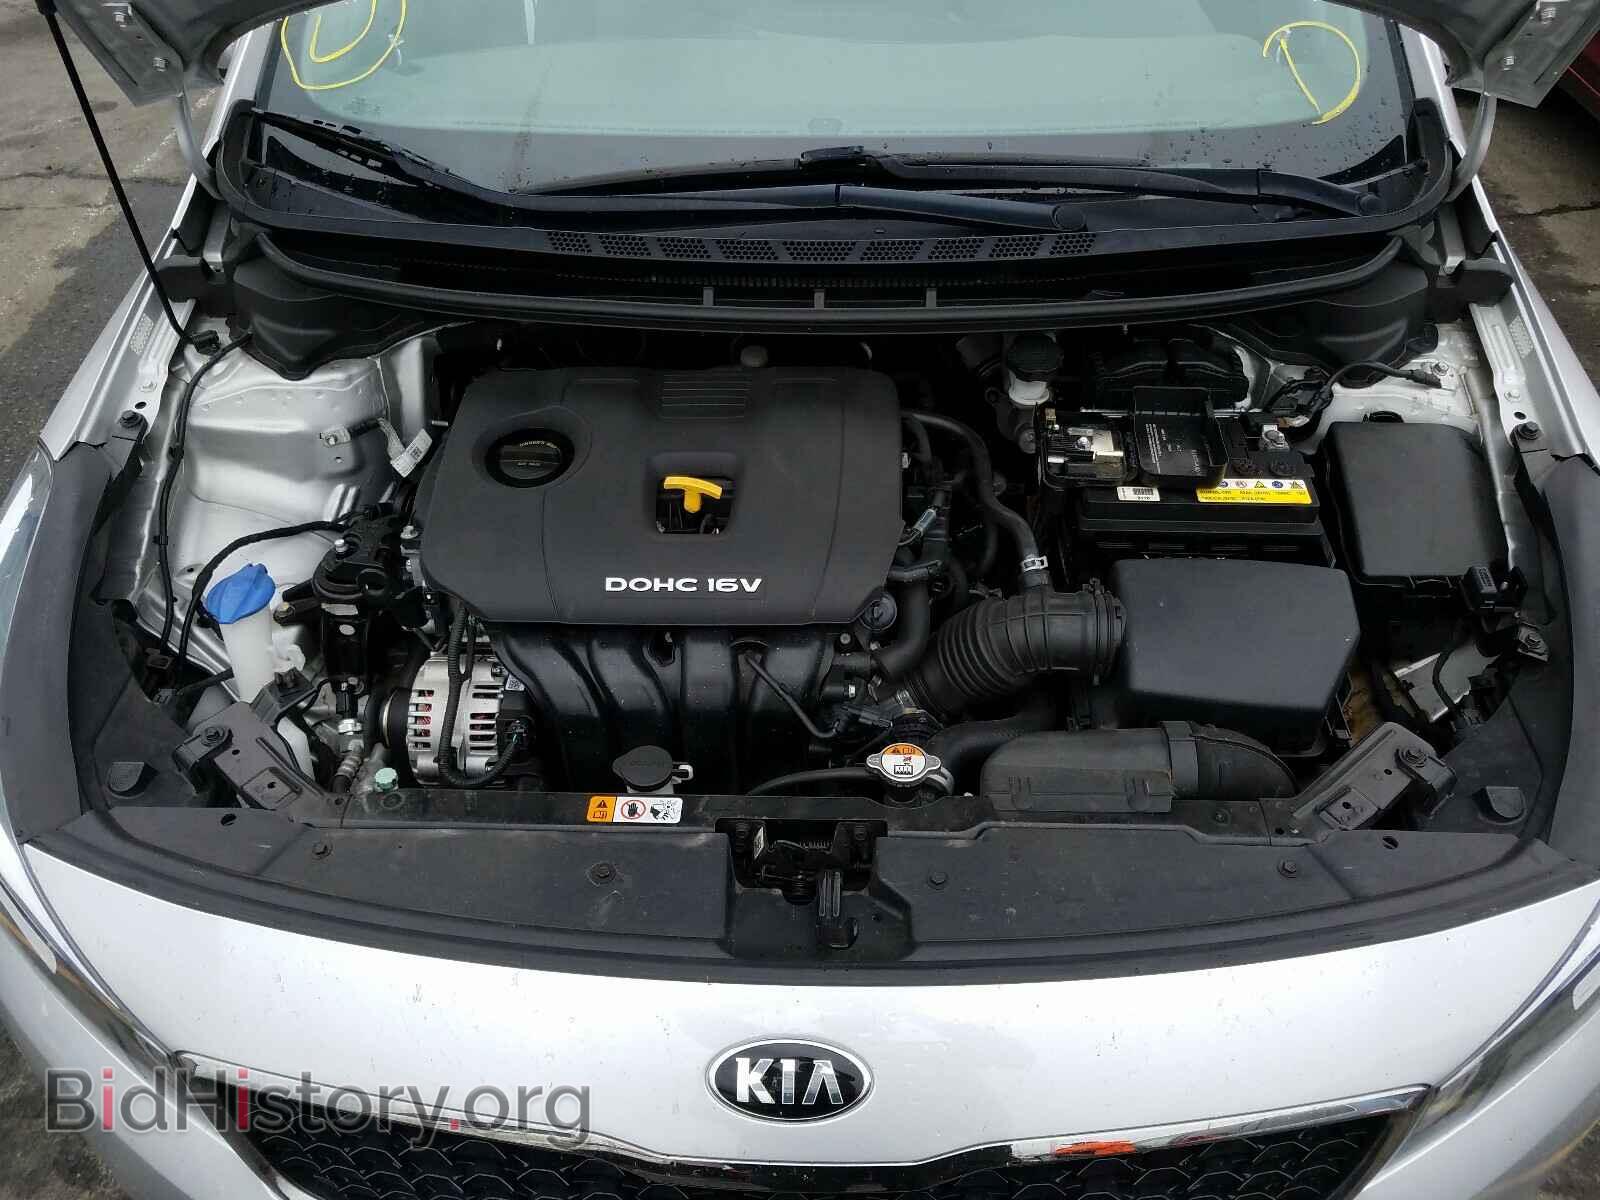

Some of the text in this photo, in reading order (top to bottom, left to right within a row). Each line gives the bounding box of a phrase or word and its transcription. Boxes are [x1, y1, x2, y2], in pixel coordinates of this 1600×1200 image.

[605, 577, 762, 593] DOHC 16V
[735, 1057, 844, 1105] KIA
